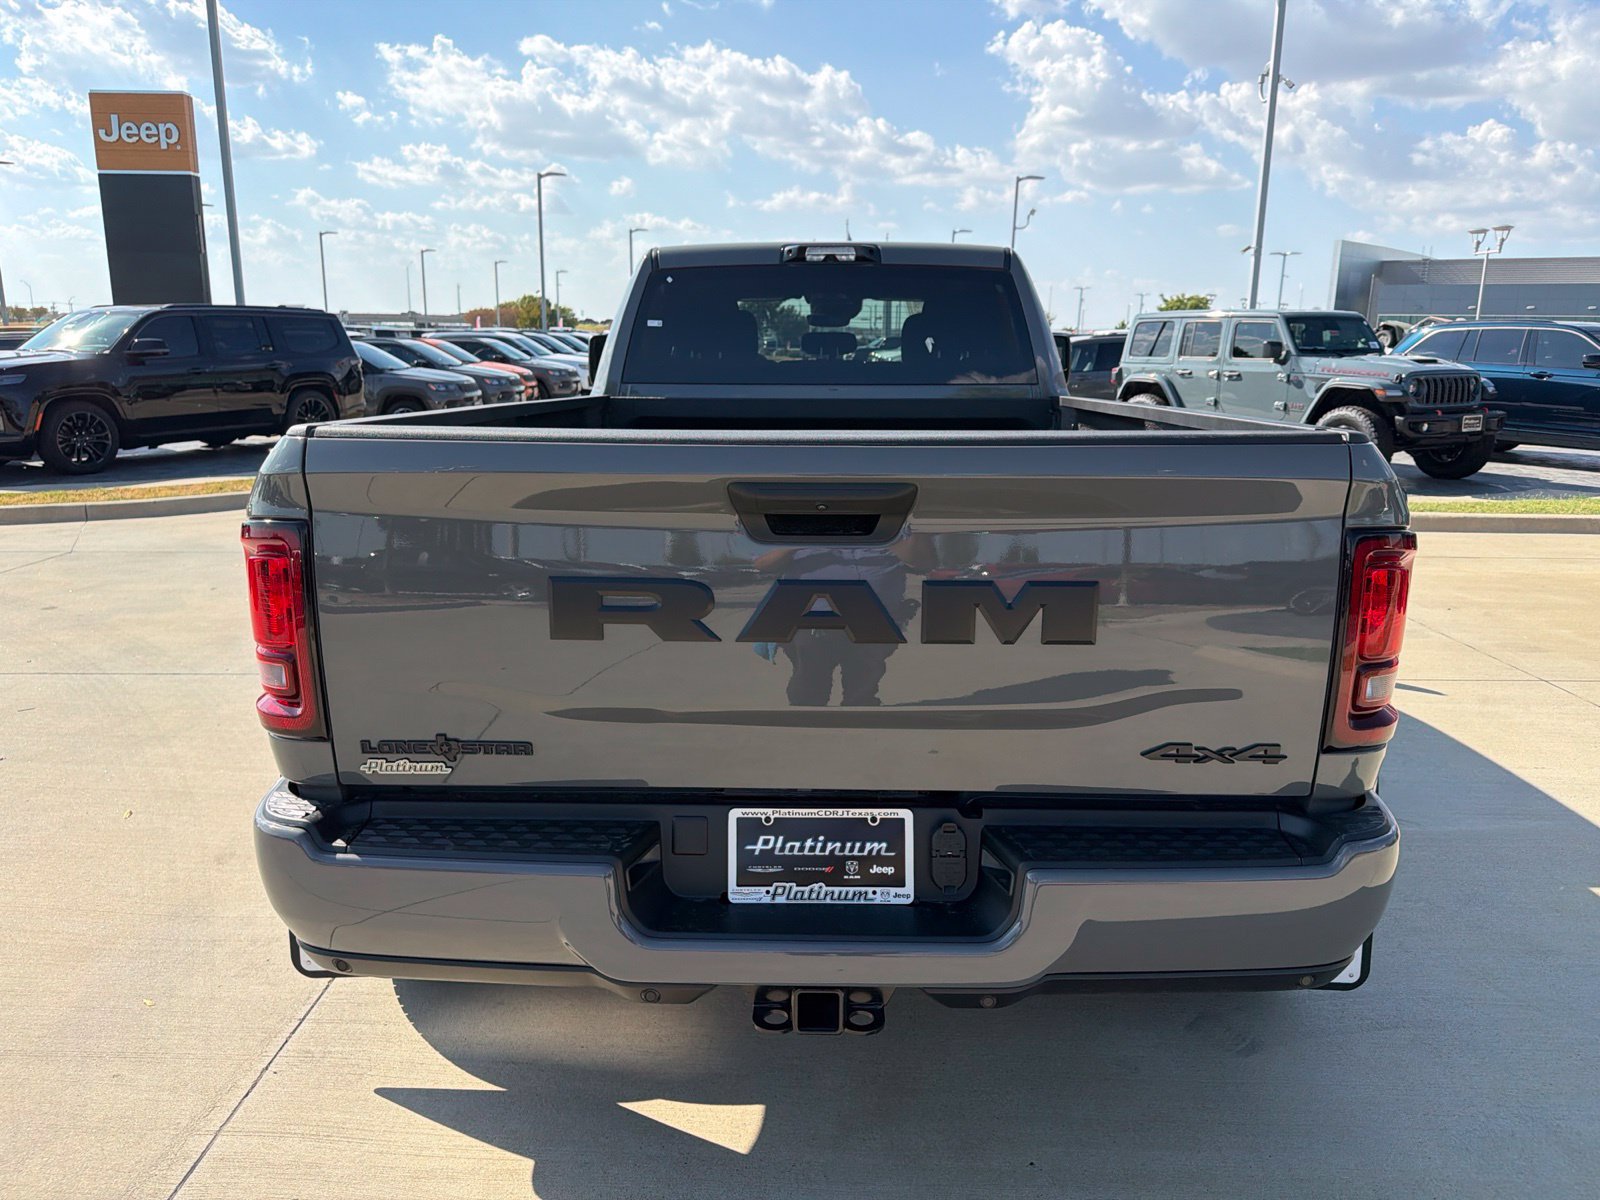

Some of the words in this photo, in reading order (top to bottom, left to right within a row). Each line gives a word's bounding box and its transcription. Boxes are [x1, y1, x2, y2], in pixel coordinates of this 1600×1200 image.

[98, 113, 180, 150] Jeep
[548, 576, 1100, 644] RAM
[360, 740, 432, 754] LONE
[460, 740, 534, 755] STAR
[359, 757, 453, 775] Platinum
[744, 835, 896, 856] Platinum
[869, 864, 895, 876] Jeep
[764, 884, 877, 902] Platinum
[892, 892, 911, 900] Jeep
